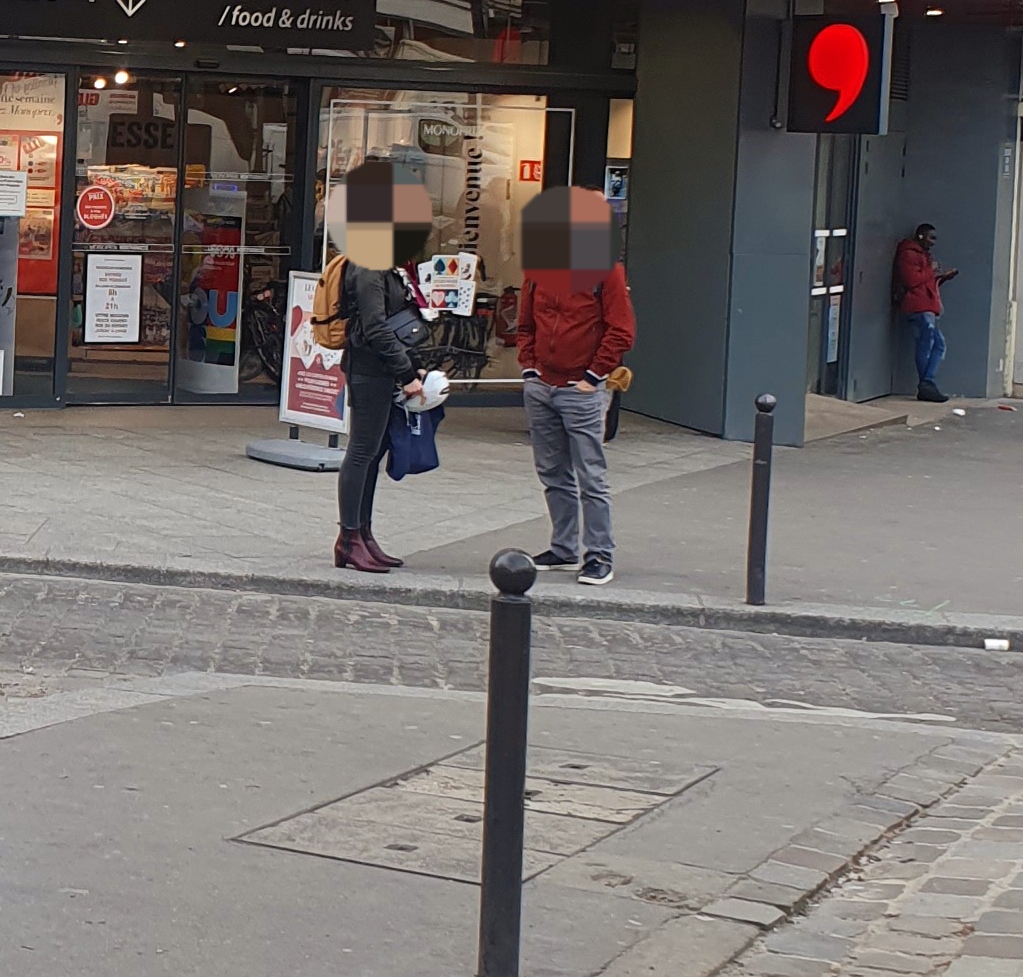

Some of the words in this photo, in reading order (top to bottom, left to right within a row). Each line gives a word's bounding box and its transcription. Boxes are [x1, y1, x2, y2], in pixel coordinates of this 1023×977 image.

[296, 8, 354, 32] drinks
[15, 94, 56, 104] semaine
[458, 147, 483, 254] ienvenue
